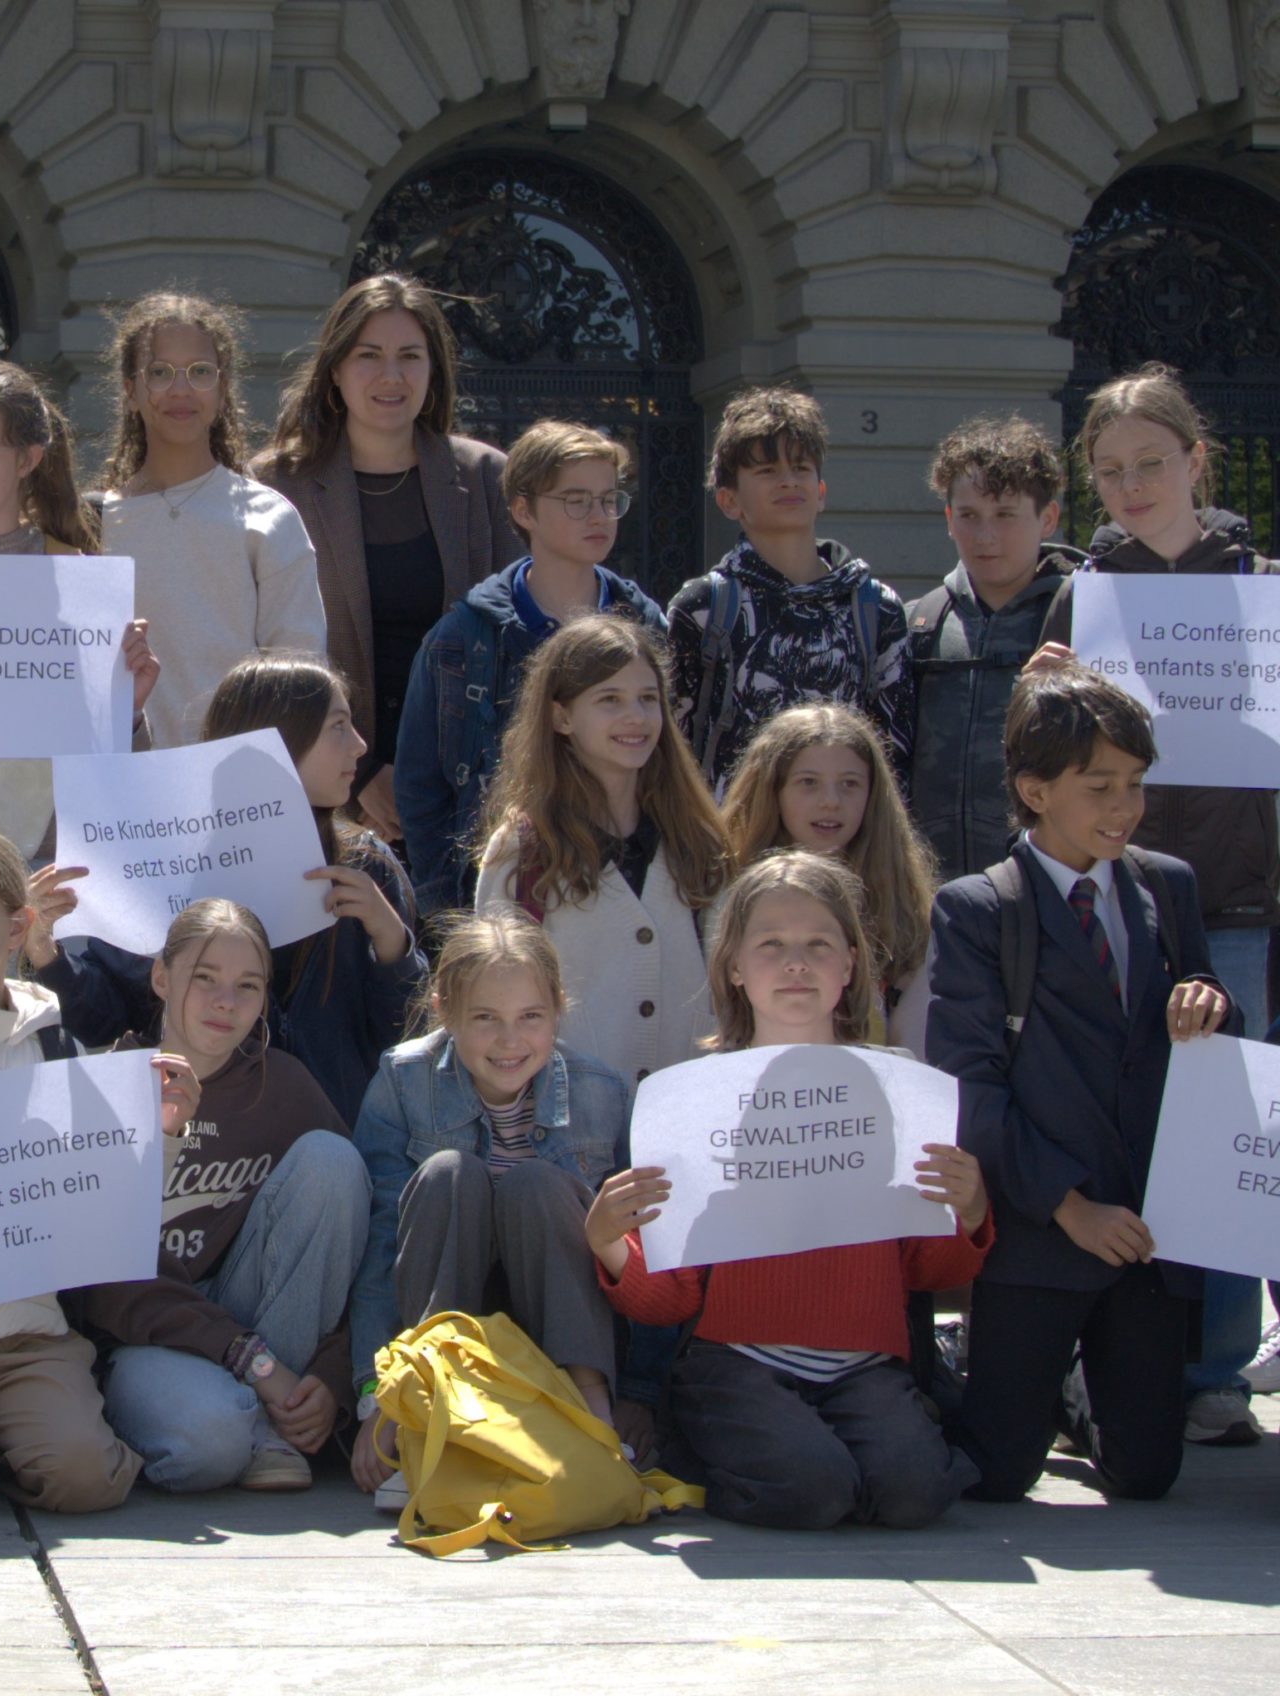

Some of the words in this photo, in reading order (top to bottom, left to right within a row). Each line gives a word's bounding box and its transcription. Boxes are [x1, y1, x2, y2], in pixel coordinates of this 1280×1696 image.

[861, 410, 878, 434] 3
[1141, 622, 1165, 640] La
[1090, 656, 1128, 675] des
[1134, 657, 1215, 677] enfants
[1221, 659, 1280, 683] s'eng
[1157, 691, 1224, 711] faveur
[1230, 693, 1277, 712] de...
[83, 822, 114, 843] Die
[117, 799, 285, 840] Kinderkonferenz
[123, 858, 166, 880] setzt
[170, 851, 213, 876] sich
[219, 845, 254, 868] ein
[738, 1088, 786, 1111] FÜR
[794, 1085, 848, 1109] EINE
[710, 1116, 876, 1148] GEWALTFREIE
[723, 1151, 865, 1181] ERZIEHUNG
[9, 1178, 56, 1205] sich
[63, 1171, 100, 1194] ein
[163, 1153, 272, 1209] icago
[2, 1225, 52, 1248] für...
